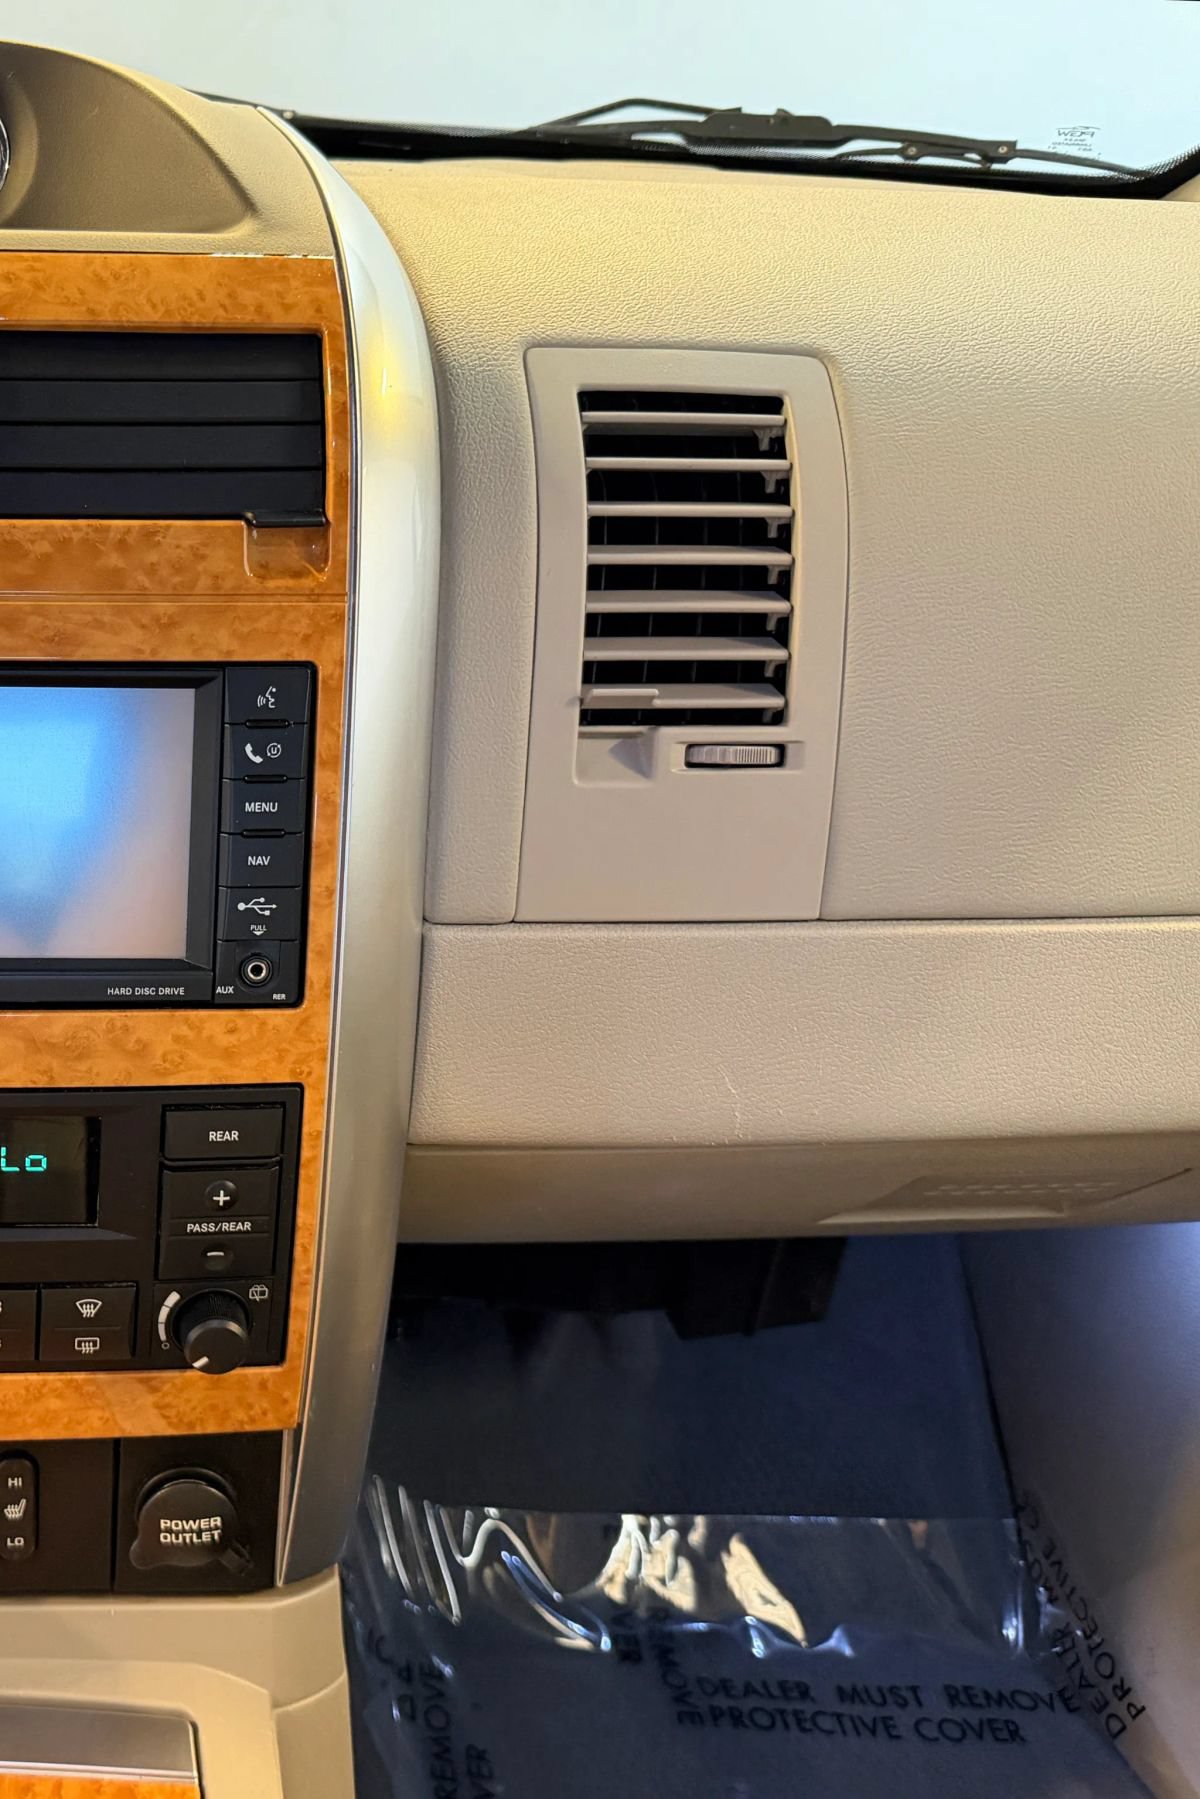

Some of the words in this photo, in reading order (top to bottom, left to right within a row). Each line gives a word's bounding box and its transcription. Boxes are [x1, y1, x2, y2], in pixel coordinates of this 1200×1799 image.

[244, 802, 278, 813] MENU
[247, 855, 271, 866] NAV
[107, 986, 132, 996] HARD
[134, 986, 157, 996] DISC
[158, 986, 185, 996] DRIVE
[216, 986, 234, 994] AUX
[208, 1130, 239, 1142] REAR
[186, 1221, 252, 1234] PASS/REAR
[7, 1477, 22, 1487] HI
[159, 1516, 222, 1531] POWER
[7, 1537, 24, 1546] LO
[159, 1530, 221, 1544] OUTLET
[1042, 1541, 1146, 1721] PROTECTIVE
[1057, 1621, 1128, 1741] DEALER
[699, 1675, 815, 1702] DEALER
[836, 1682, 925, 1712] MUST
[942, 1682, 1081, 1715] REMOVE
[708, 1703, 902, 1741] PROTECTIVE
[913, 1715, 1028, 1745] COVER
